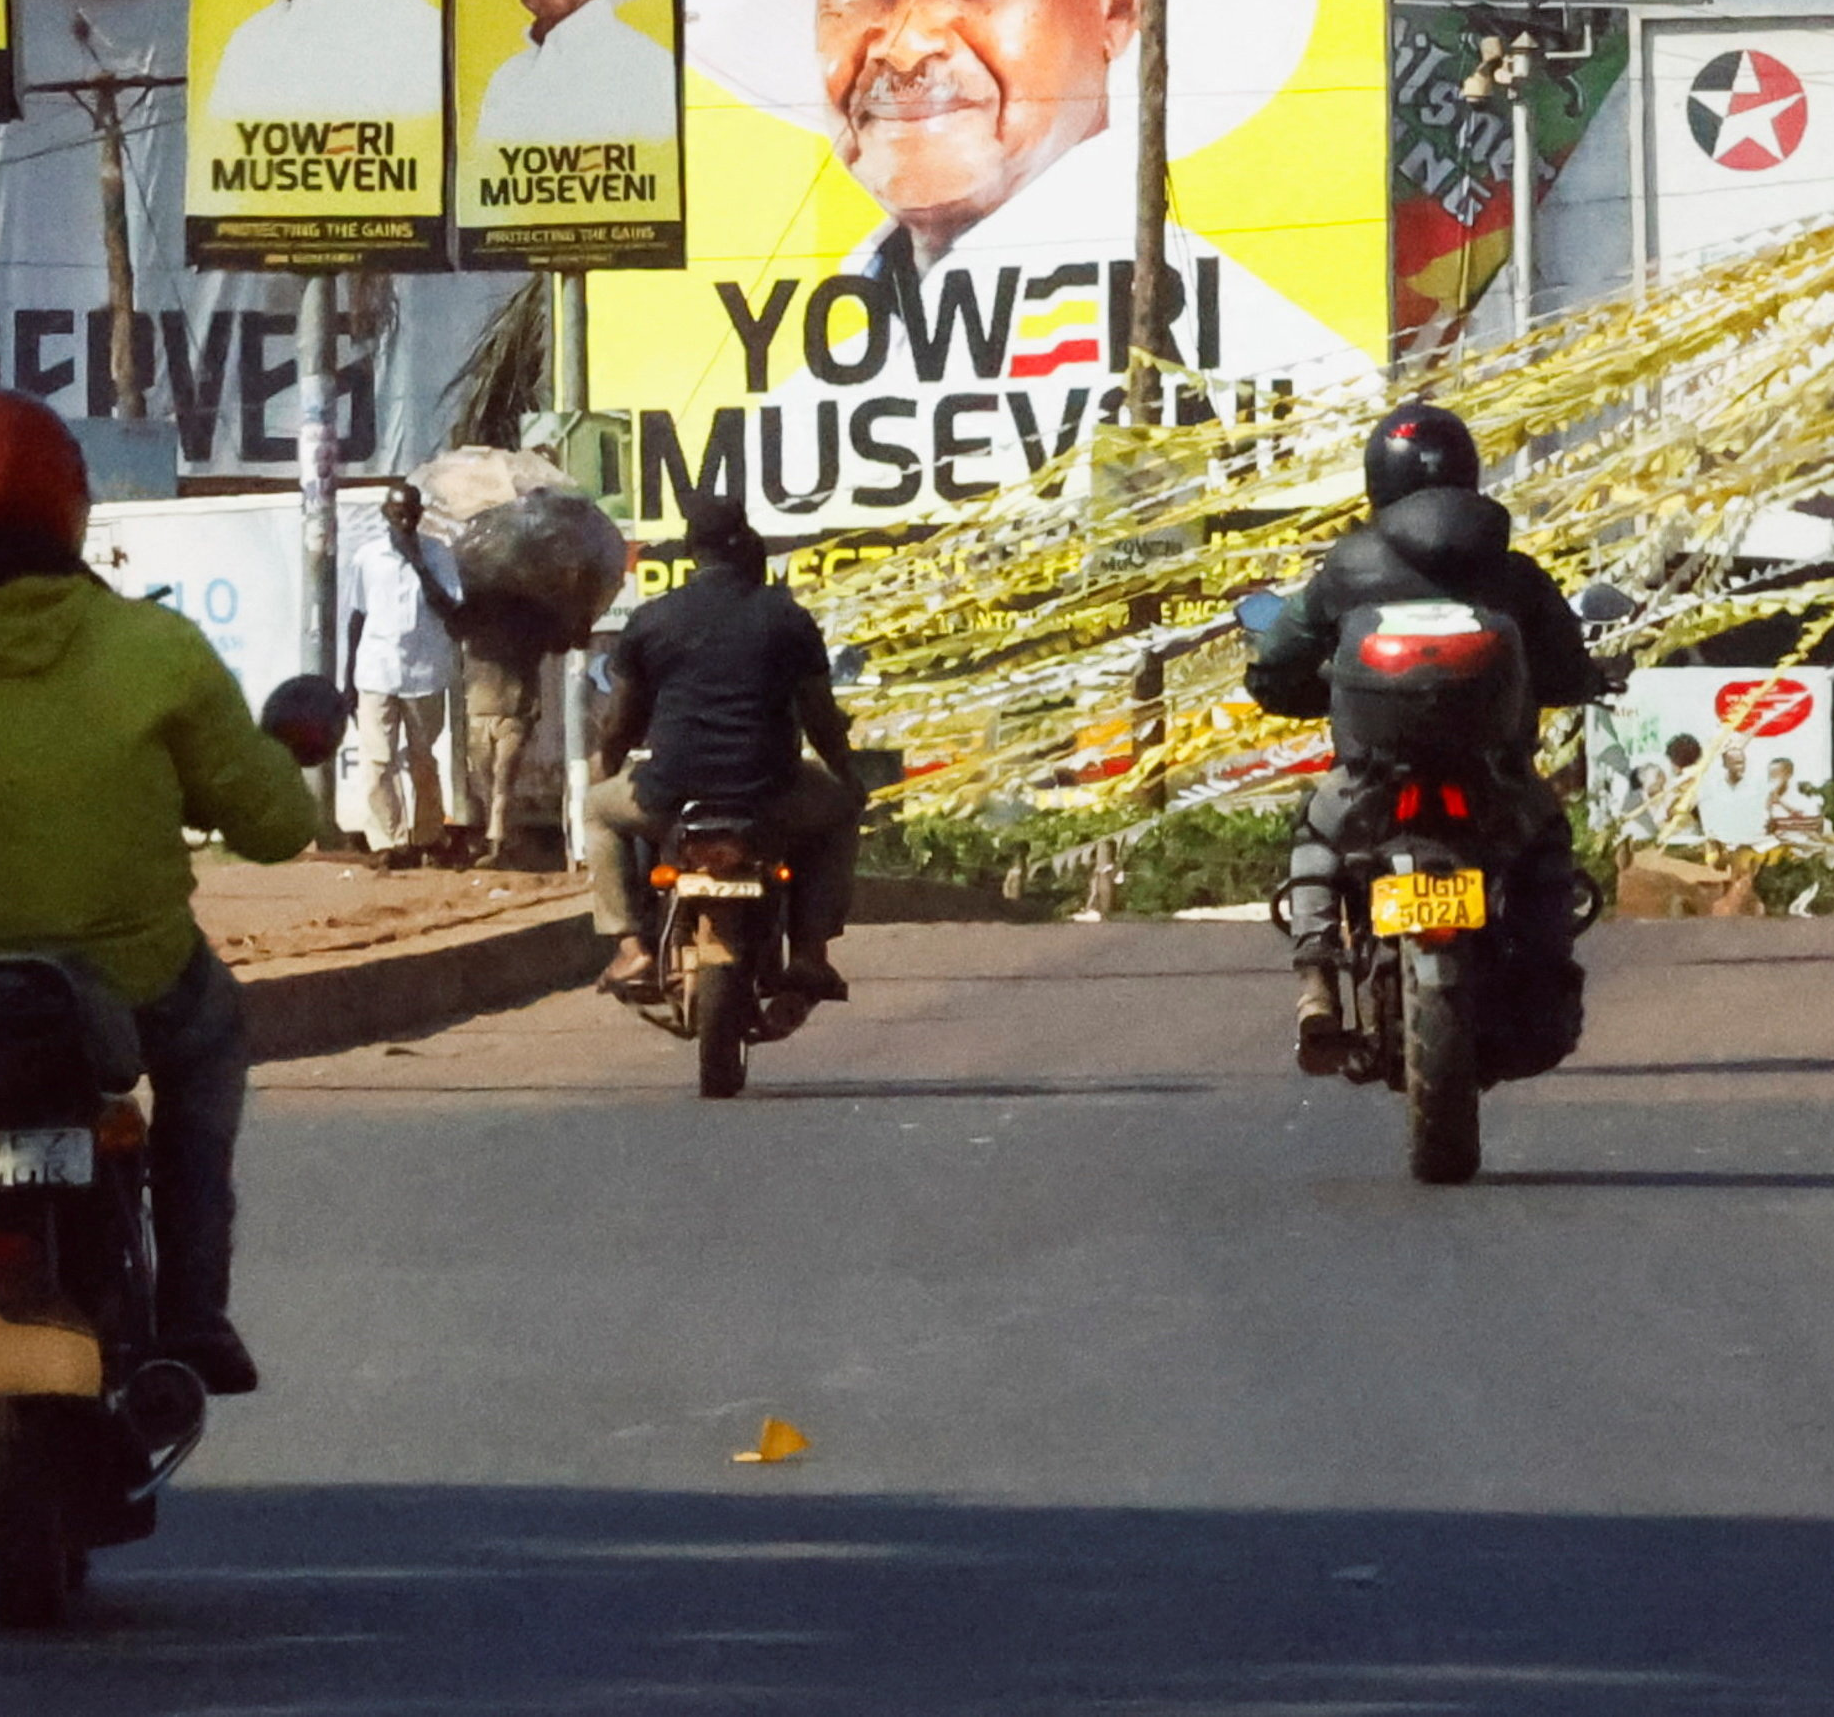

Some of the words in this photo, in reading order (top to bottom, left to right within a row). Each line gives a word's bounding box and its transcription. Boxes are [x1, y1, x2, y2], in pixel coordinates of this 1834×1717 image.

[236, 121, 394, 156] YOWERI
[211, 157, 417, 192] MUSEVENI
[499, 144, 635, 175] YOWERI
[480, 174, 656, 207] MUSEVENI
[326, 222, 357, 238] THE
[362, 221, 414, 238] GAINS
[611, 226, 655, 240] GAINS
[715, 256, 1219, 393] YOWERI
[1414, 875, 1467, 898] UGD
[1400, 900, 1469, 927] 502A
